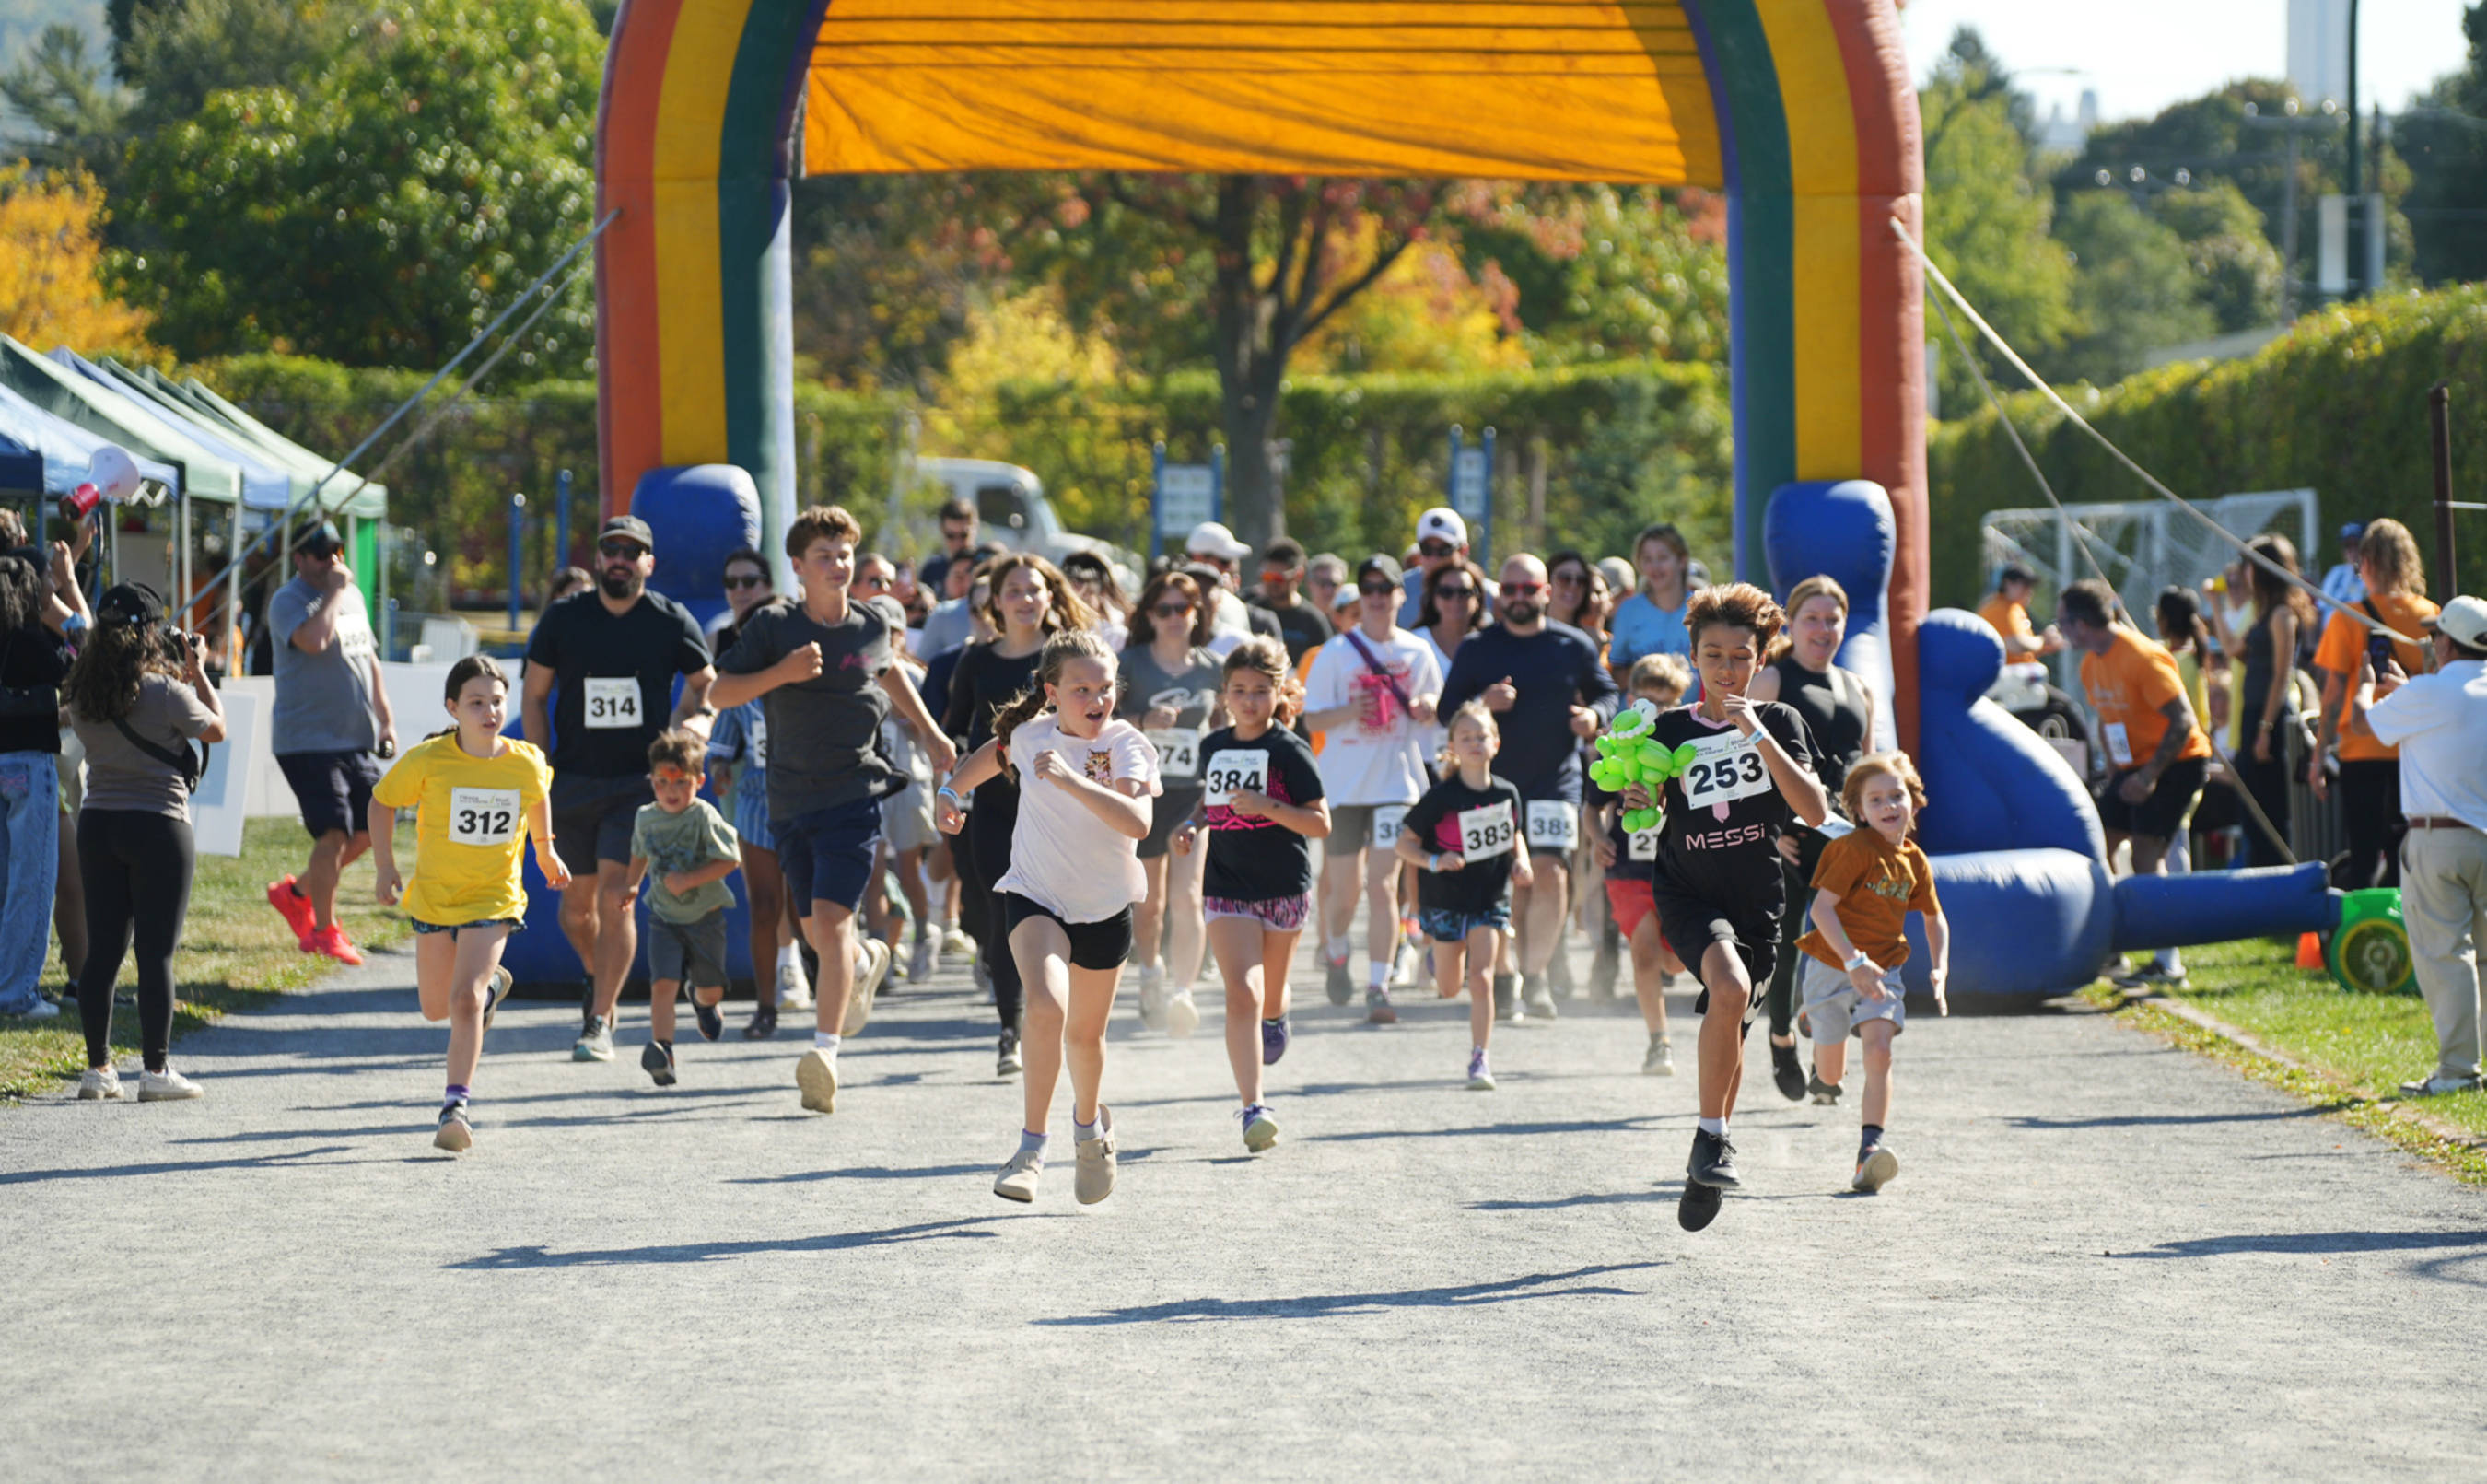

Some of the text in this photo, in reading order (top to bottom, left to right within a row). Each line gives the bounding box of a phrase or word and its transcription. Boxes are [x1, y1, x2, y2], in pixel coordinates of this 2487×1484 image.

[590, 695, 636, 718] 314
[1153, 743, 1191, 765] 74
[1209, 769, 1263, 794] 384
[1689, 752, 1763, 795] 253
[457, 809, 510, 835] 312
[1532, 817, 1573, 837] 385
[1466, 821, 1512, 850] 383
